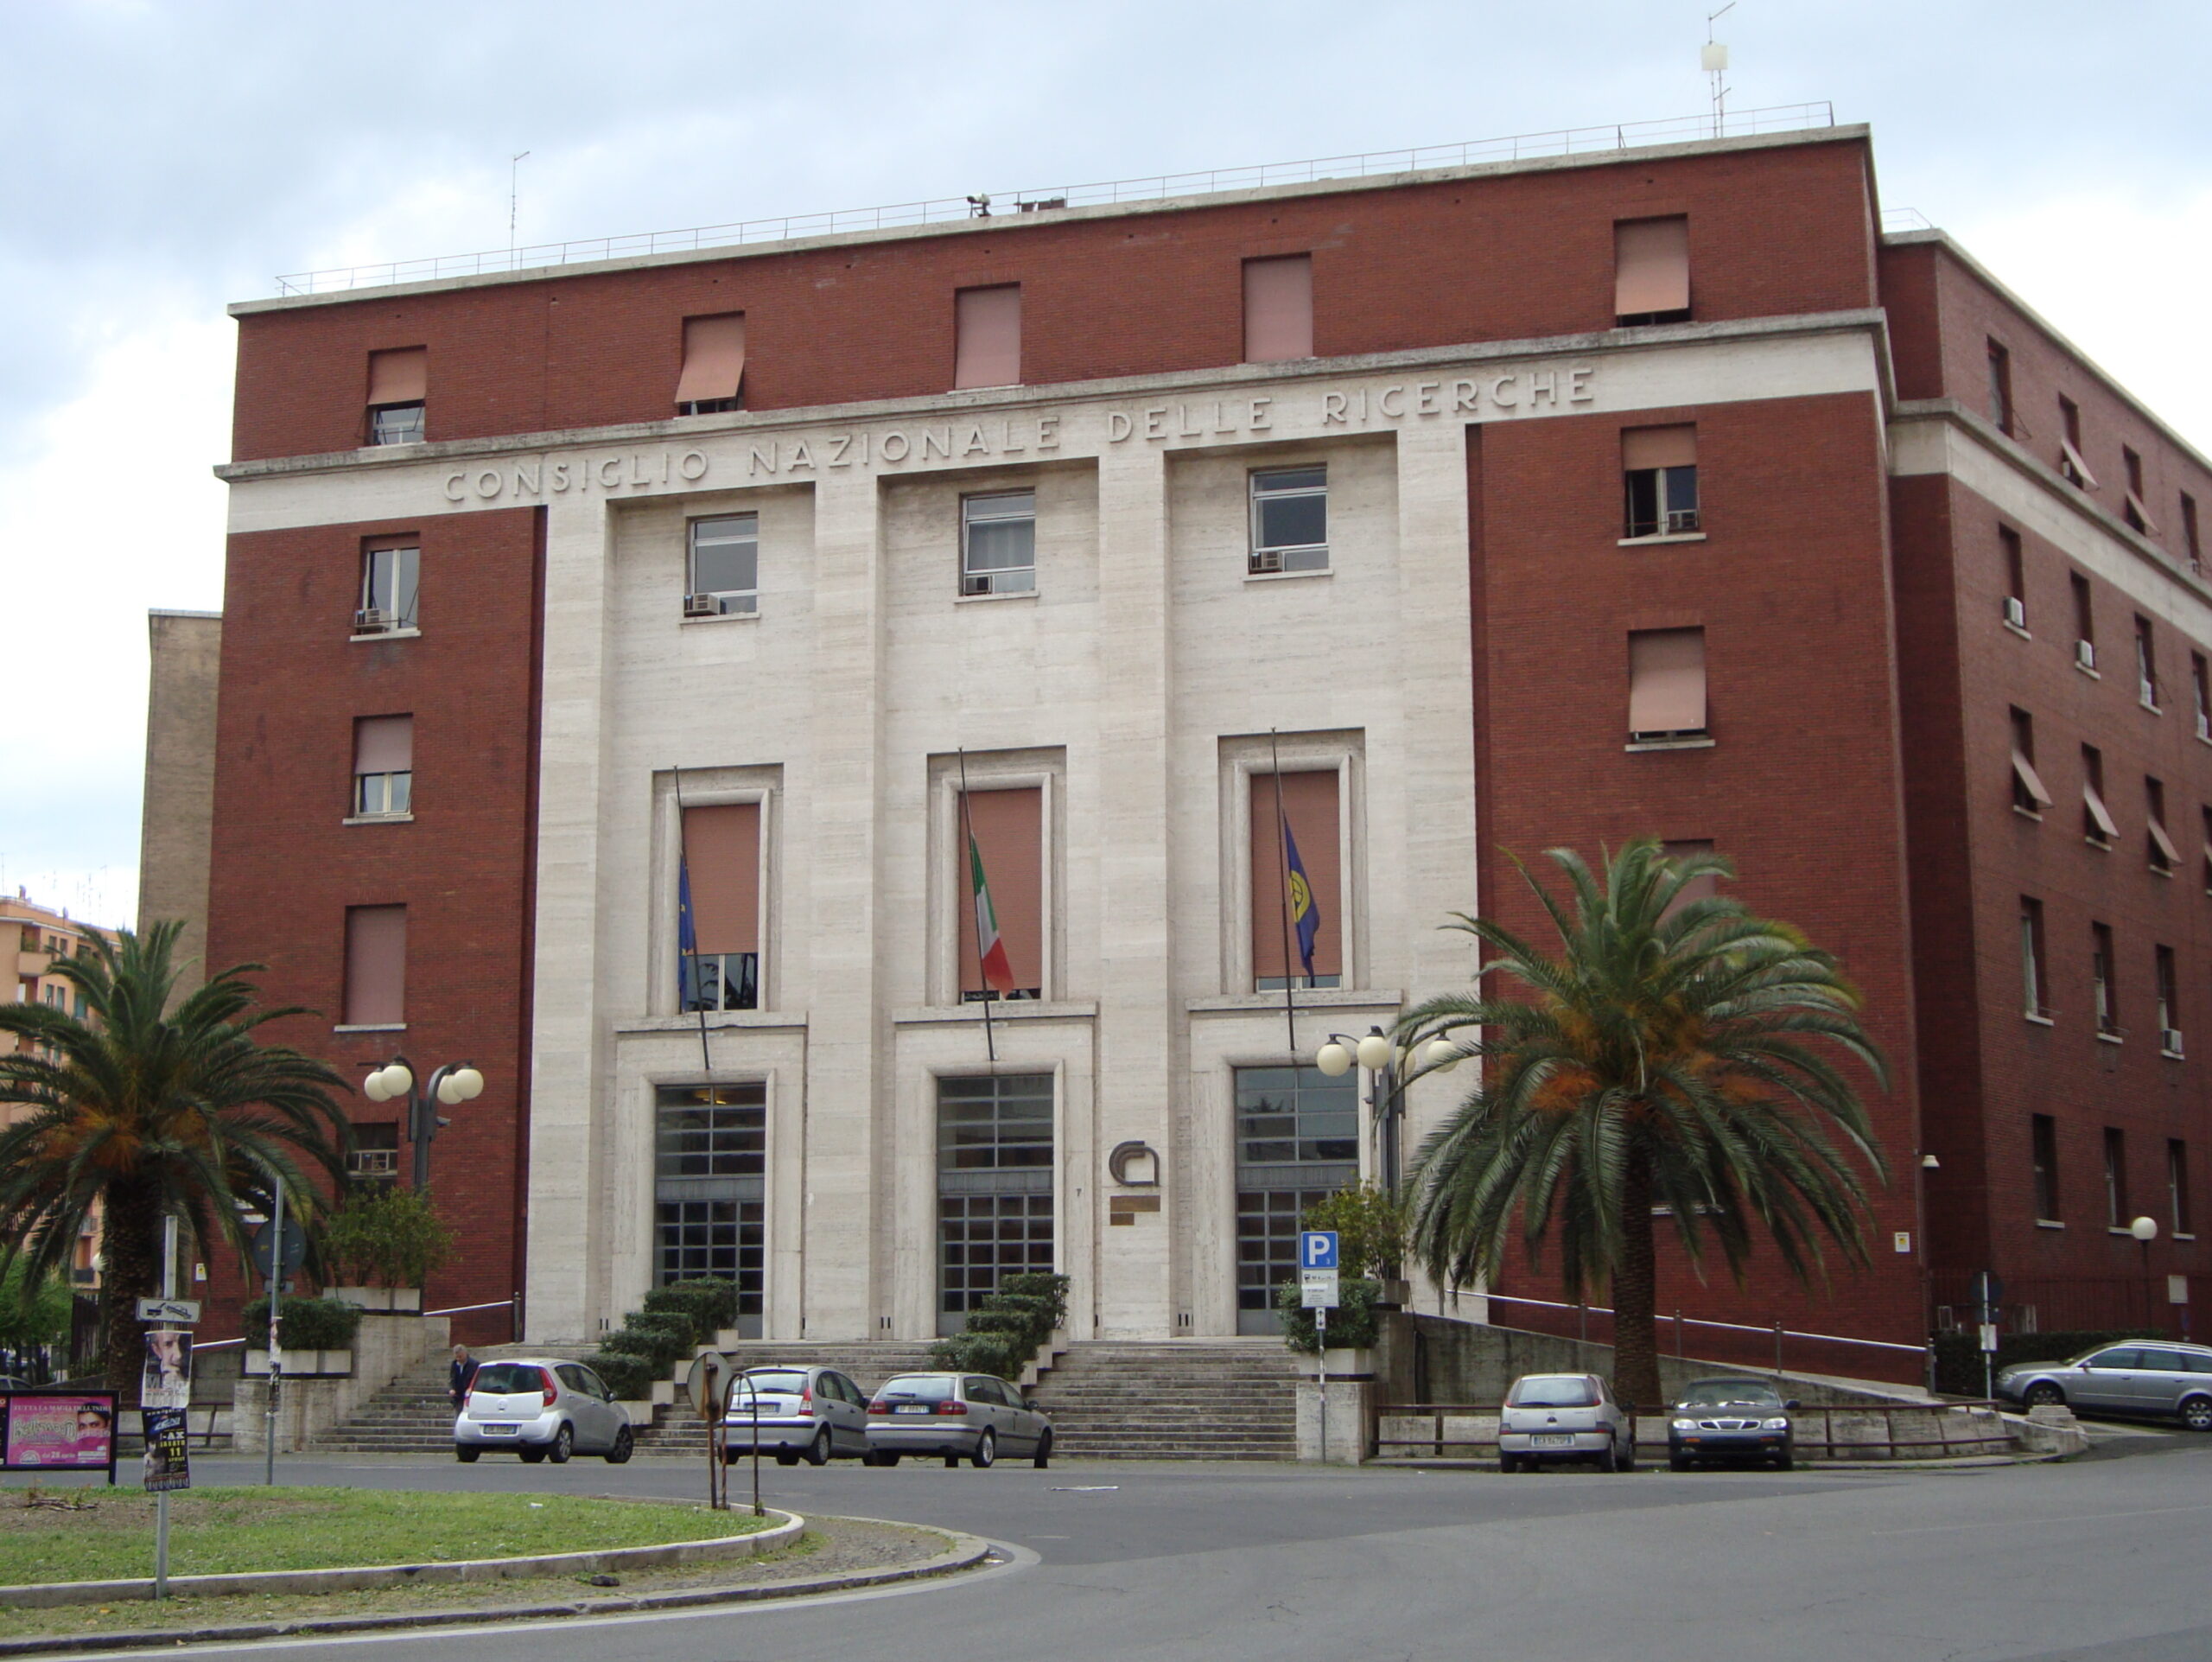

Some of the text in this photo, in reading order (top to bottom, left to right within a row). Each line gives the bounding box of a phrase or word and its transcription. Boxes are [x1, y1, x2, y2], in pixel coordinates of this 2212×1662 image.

[443, 367, 1595, 503] CONSIGLIO NAZIONALE DELLE RICERCHE
[1309, 1235, 1330, 1265] P
[169, 1448, 181, 1456] 11
